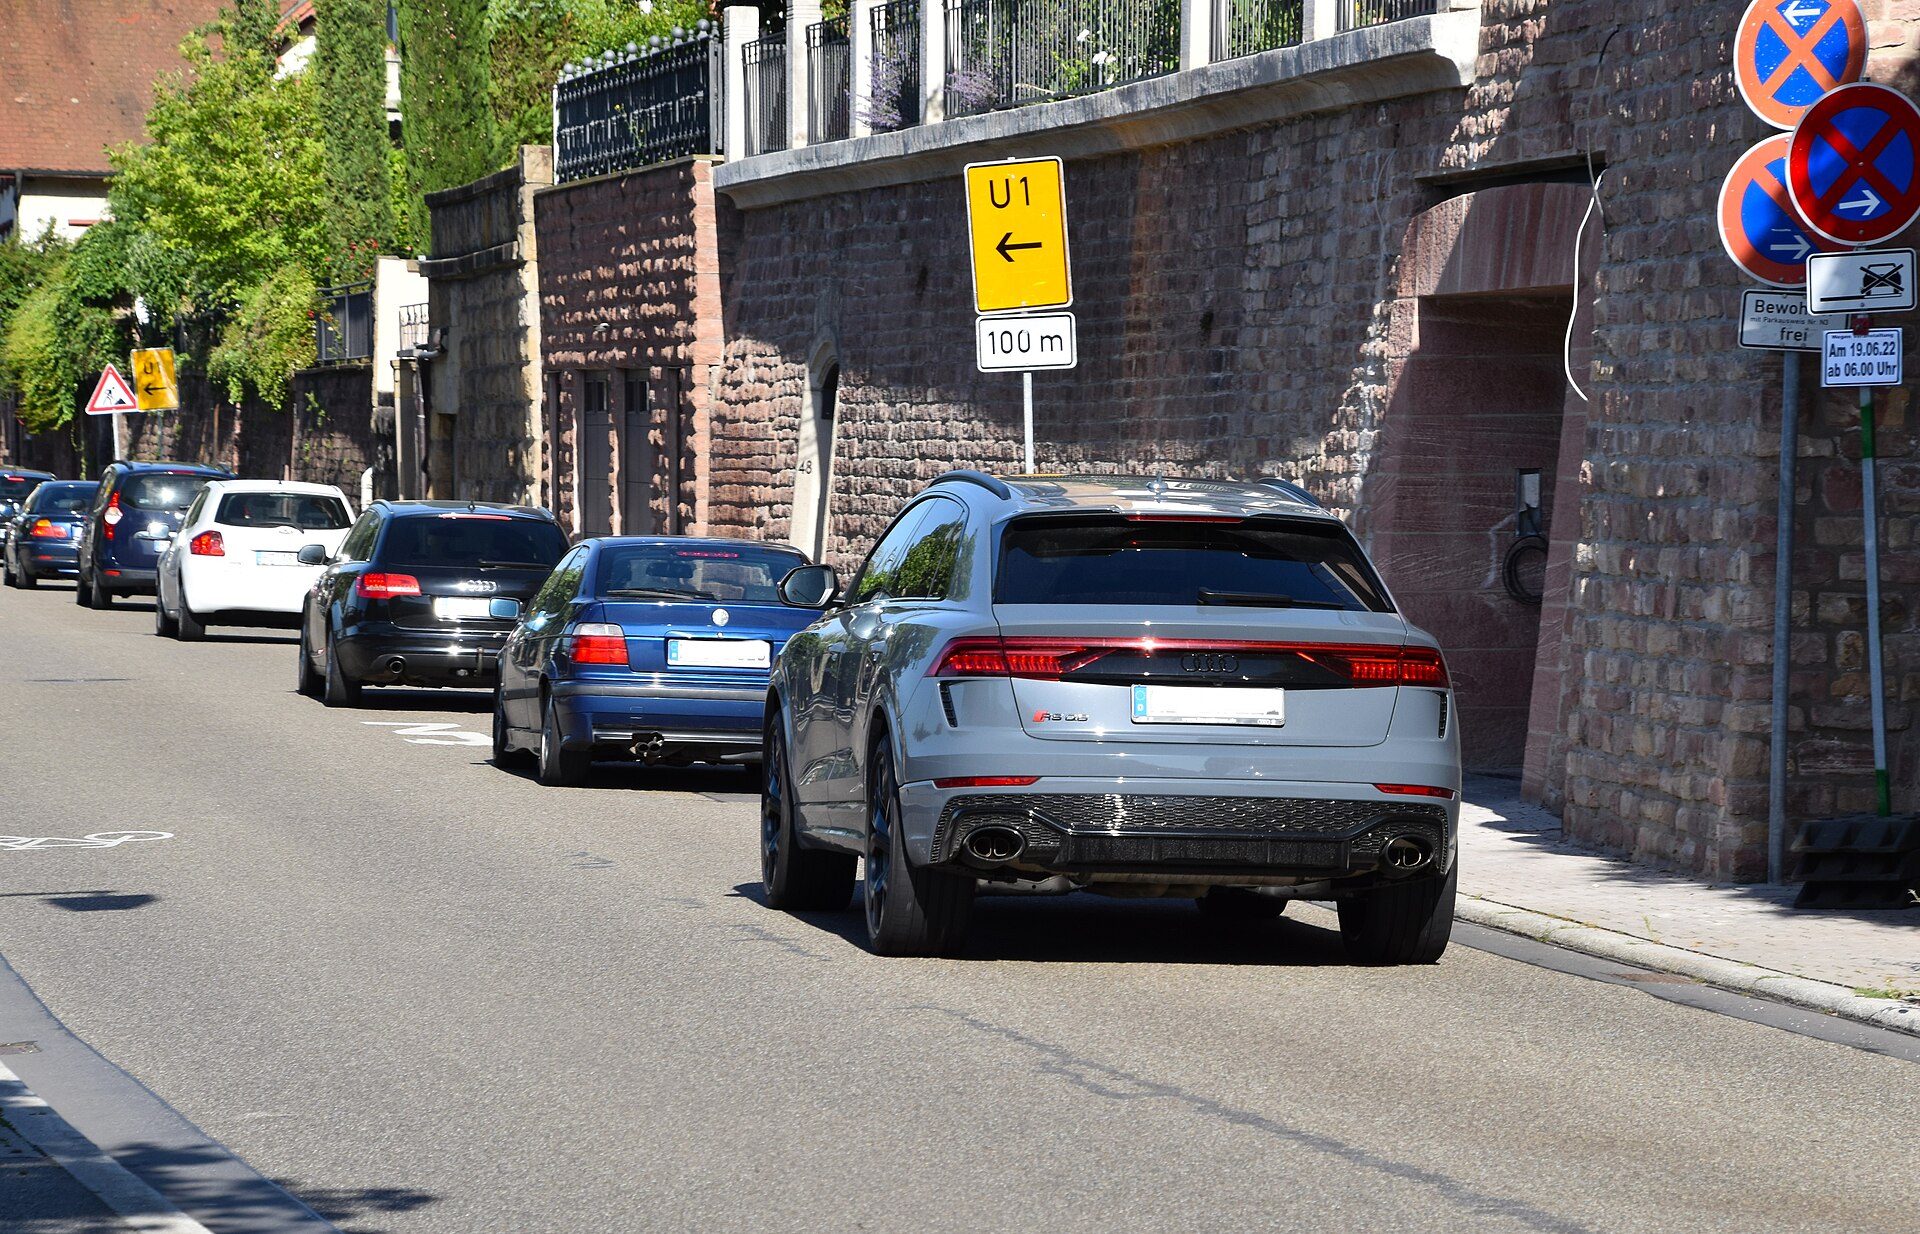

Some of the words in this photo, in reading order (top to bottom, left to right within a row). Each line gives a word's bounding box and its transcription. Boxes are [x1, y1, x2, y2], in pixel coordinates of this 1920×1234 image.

[989, 177, 1030, 209] U1
[1755, 299, 1832, 317] Bewoh
[988, 329, 1030, 355] 100
[1040, 334, 1063, 352] m
[1781, 327, 1808, 341] frei
[1829, 343, 1846, 357] Am
[1850, 341, 1896, 356] 19.06.22
[1828, 363, 1841, 377] ab
[1844, 362, 1874, 376] 06.00
[1877, 361, 1897, 375] Uhr
[798, 460, 812, 475] 48
